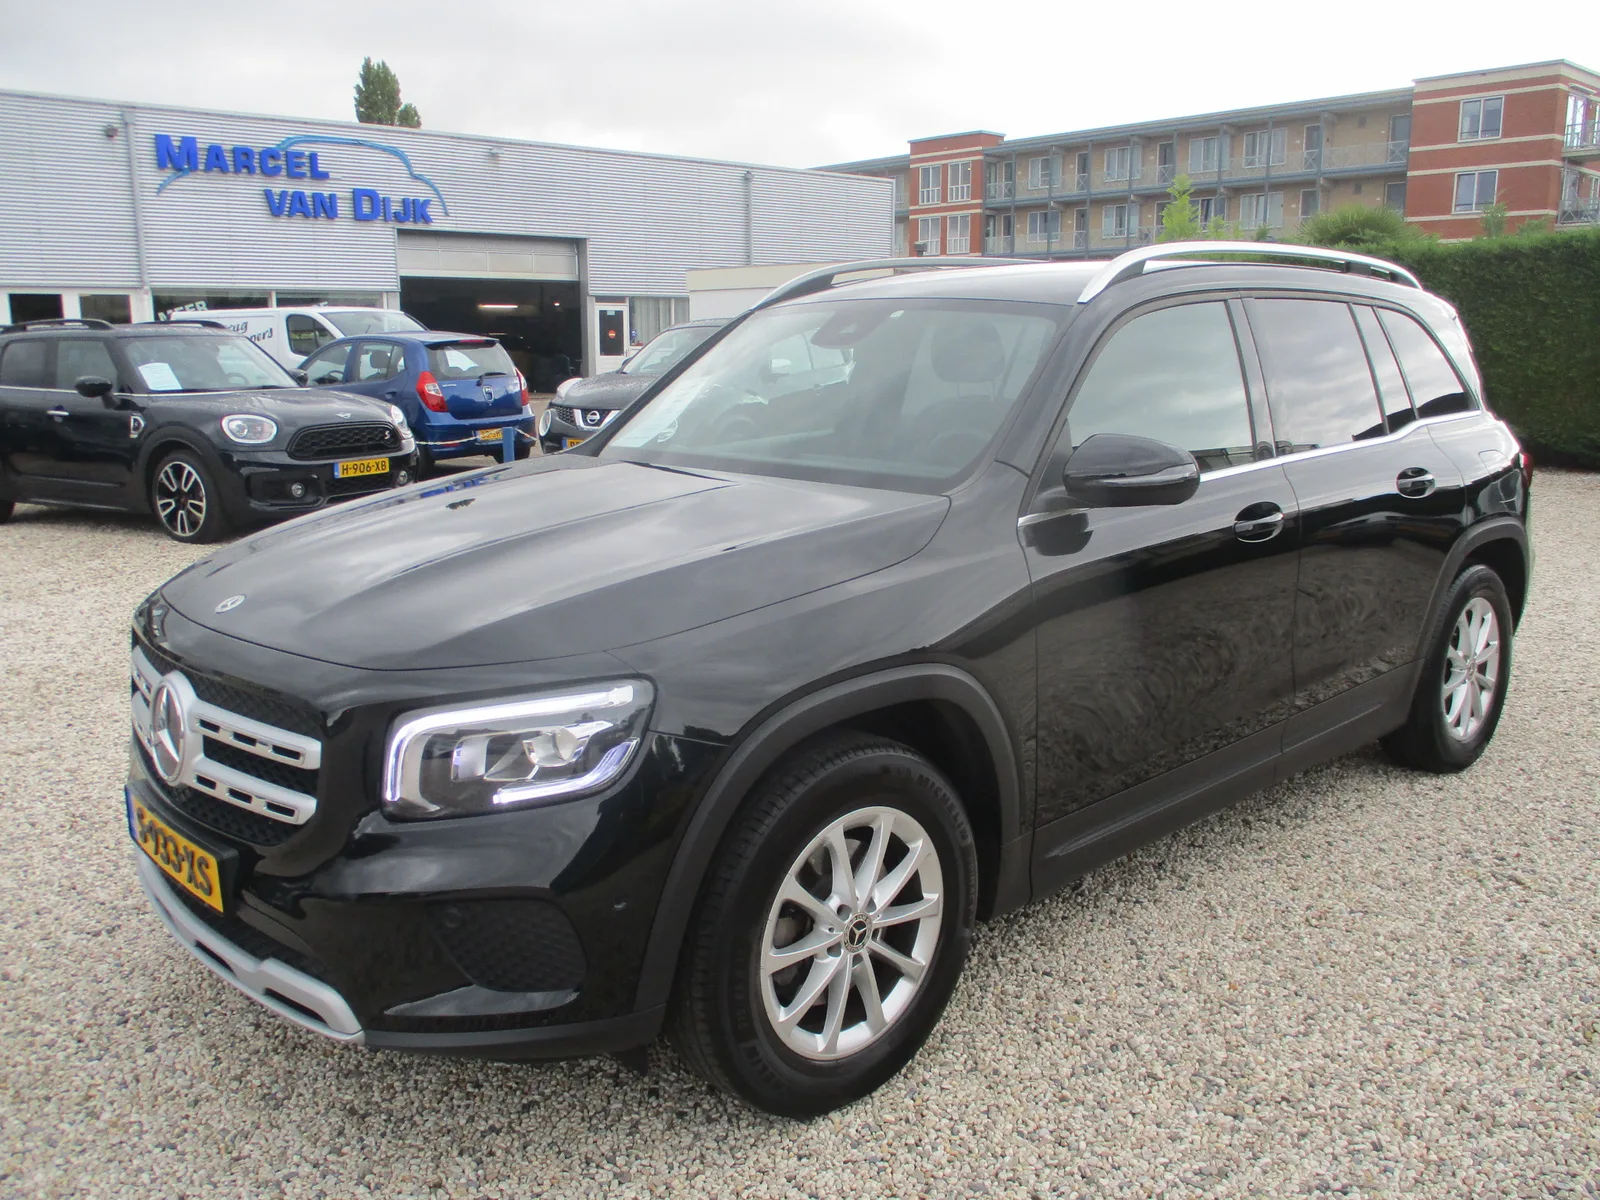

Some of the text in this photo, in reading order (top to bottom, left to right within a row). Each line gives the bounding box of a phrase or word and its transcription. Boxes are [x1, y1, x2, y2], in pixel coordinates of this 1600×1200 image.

[154, 133, 330, 180] MARCEL
[264, 187, 433, 223] VAN DIJK
[341, 460, 387, 476] H-906-XB
